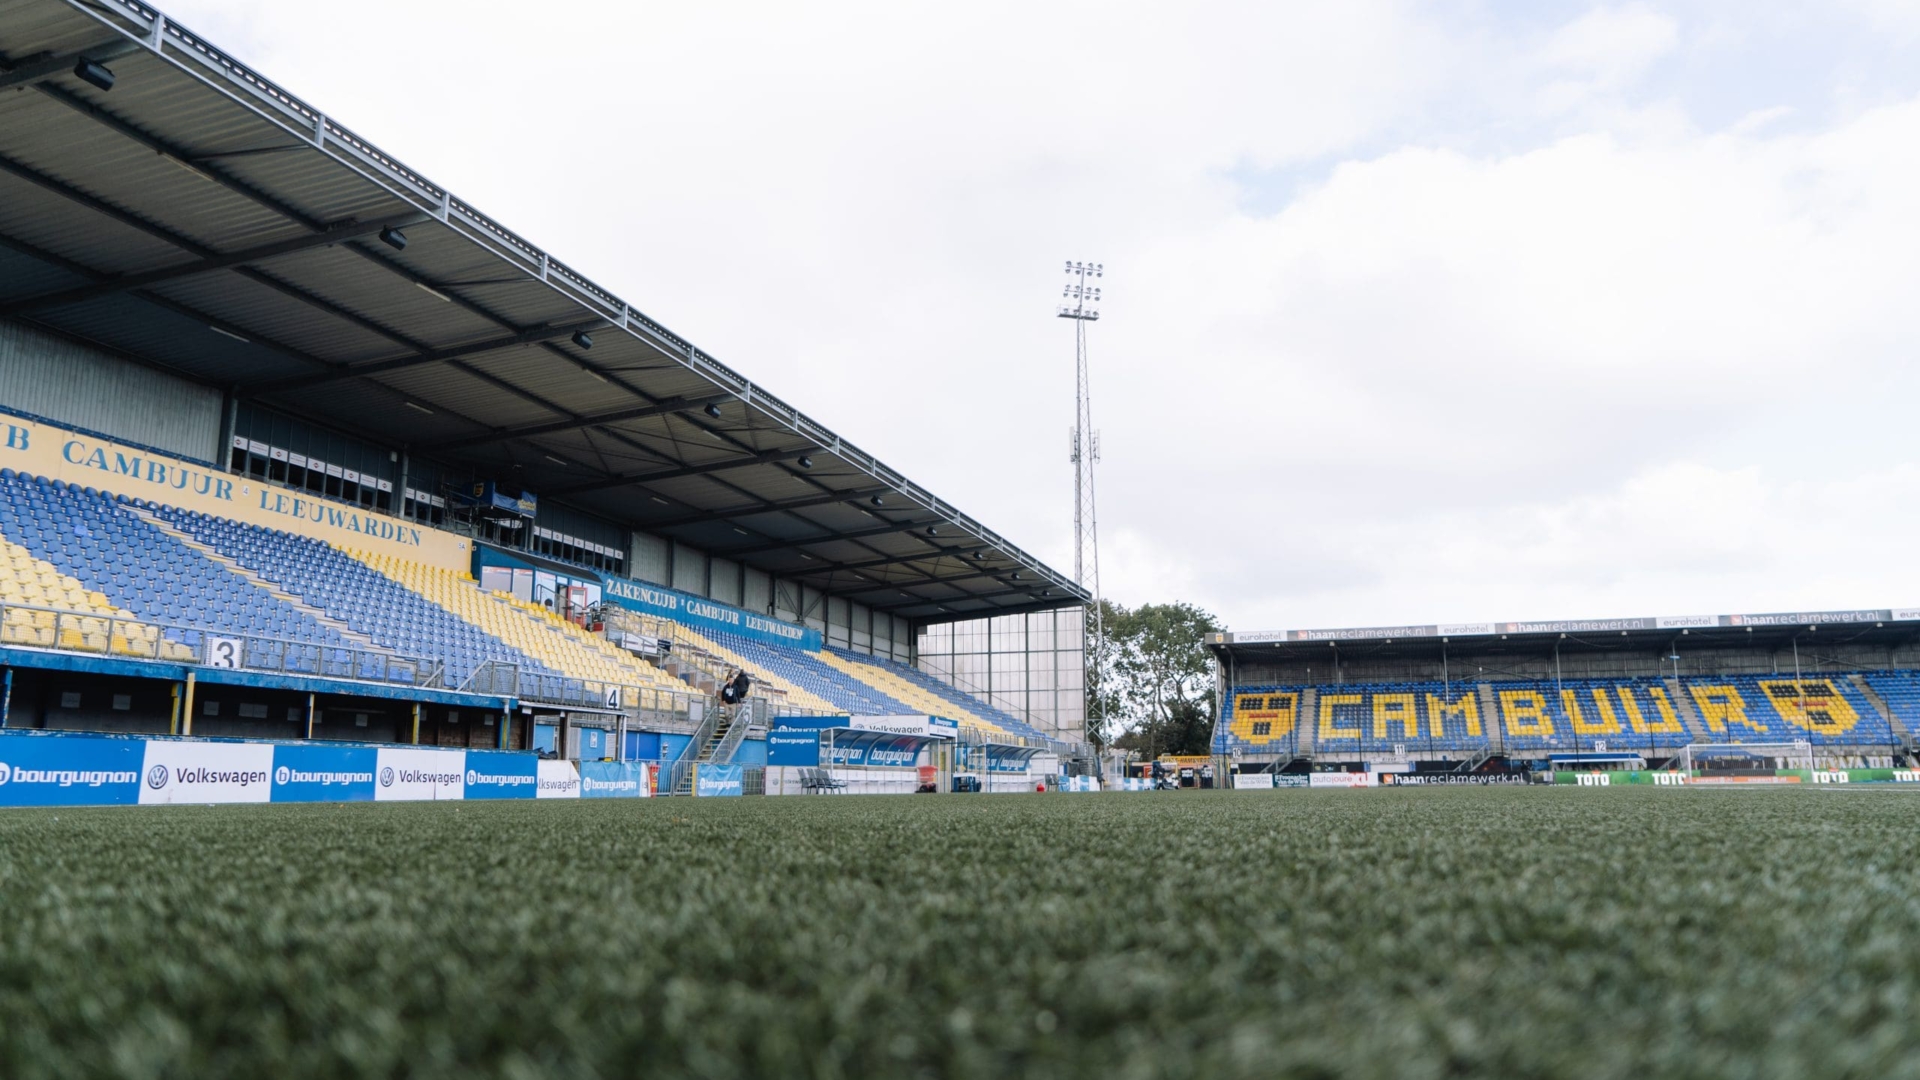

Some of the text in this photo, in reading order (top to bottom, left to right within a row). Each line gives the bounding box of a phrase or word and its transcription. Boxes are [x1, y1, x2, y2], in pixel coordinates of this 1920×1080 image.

[0, 423, 423, 547] B CAMBUUR LEEUWARDEN
[606, 578, 803, 640] ZAKENCLUB CAMBUUR LEEUWARDEN
[1663, 617, 1711, 627] eurohotel
[1743, 610, 1879, 625] haanreclamewerk.nl
[1443, 624, 1489, 635] eurohotel
[1517, 619, 1645, 632] haanreclamewerk.nl
[1239, 632, 1281, 642] eurohotel
[1308, 627, 1426, 640] haanreclamewerk.nl
[216, 641, 234, 668] 3
[608, 689, 618, 709] 4
[1318, 686, 1768, 738] CAMBUUR
[1233, 748, 1242, 758] 10
[1396, 745, 1404, 754] 11
[1596, 741, 1605, 751] 12
[12, 766, 137, 787] bourguignon
[177, 767, 266, 787] Volkswagen
[291, 769, 373, 786] bourguignon
[399, 770, 461, 786] Volkswagen
[477, 772, 534, 786] bourguignon
[1395, 772, 1524, 785] haanreclamewerk.nl
[1575, 773, 1610, 786] TOTO
[1813, 771, 1849, 784] TOTO
[537, 778, 577, 792] lkswagen
